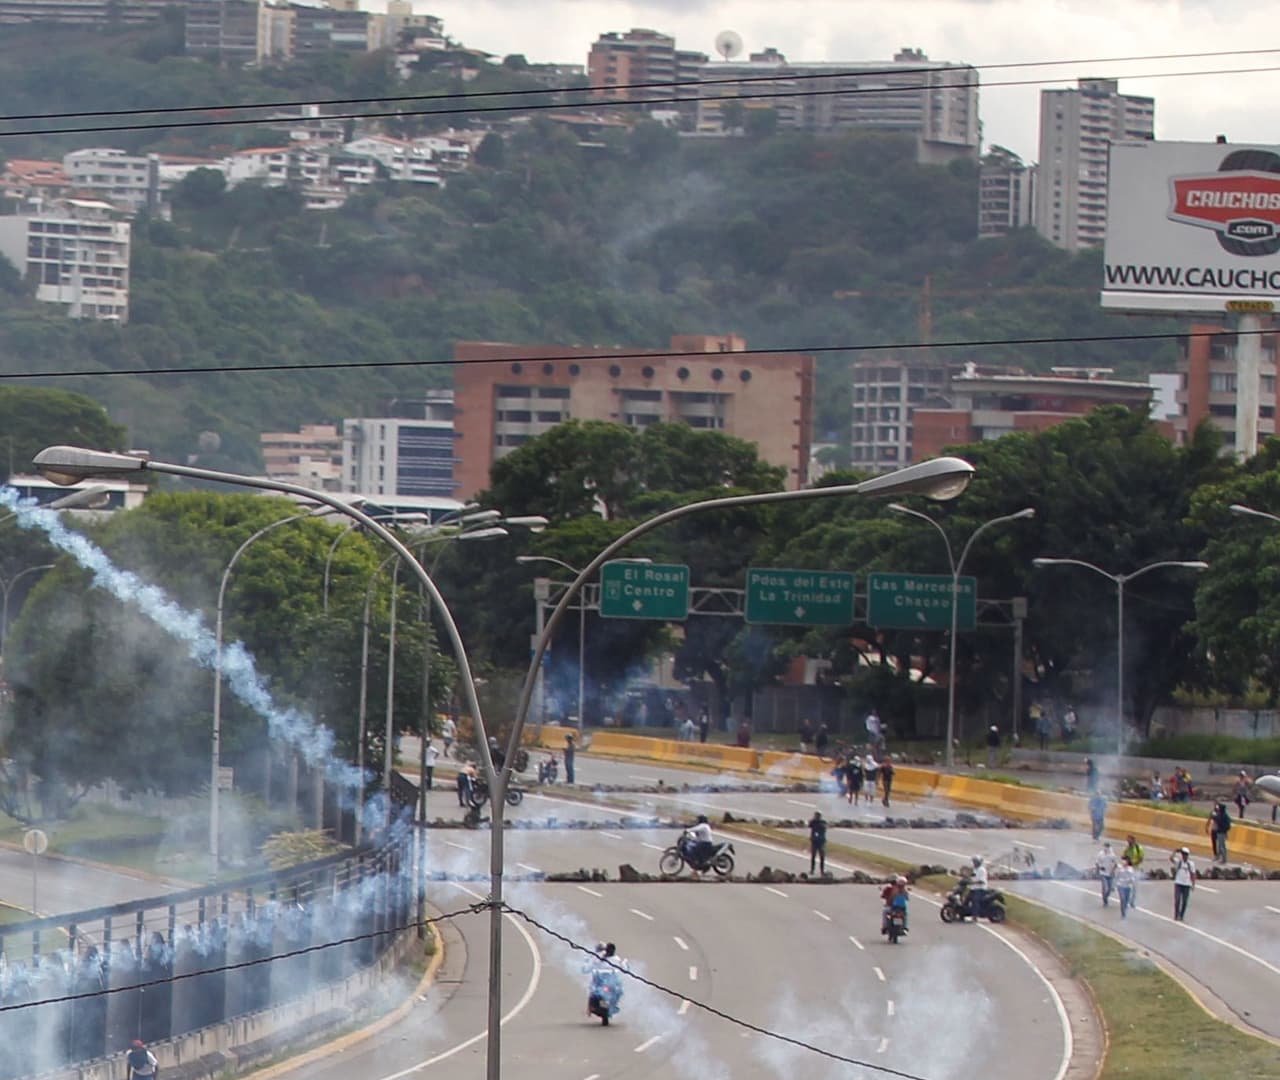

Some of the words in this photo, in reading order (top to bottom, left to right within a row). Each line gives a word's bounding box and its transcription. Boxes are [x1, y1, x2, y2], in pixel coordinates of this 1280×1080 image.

[1186, 189, 1280, 210] CAUCHOS
[624, 568, 638, 580] El
[644, 569, 684, 582] Rosal
[624, 584, 675, 597] Centro
[783, 591, 842, 603] Trinidad
[894, 595, 950, 608] Chacao
